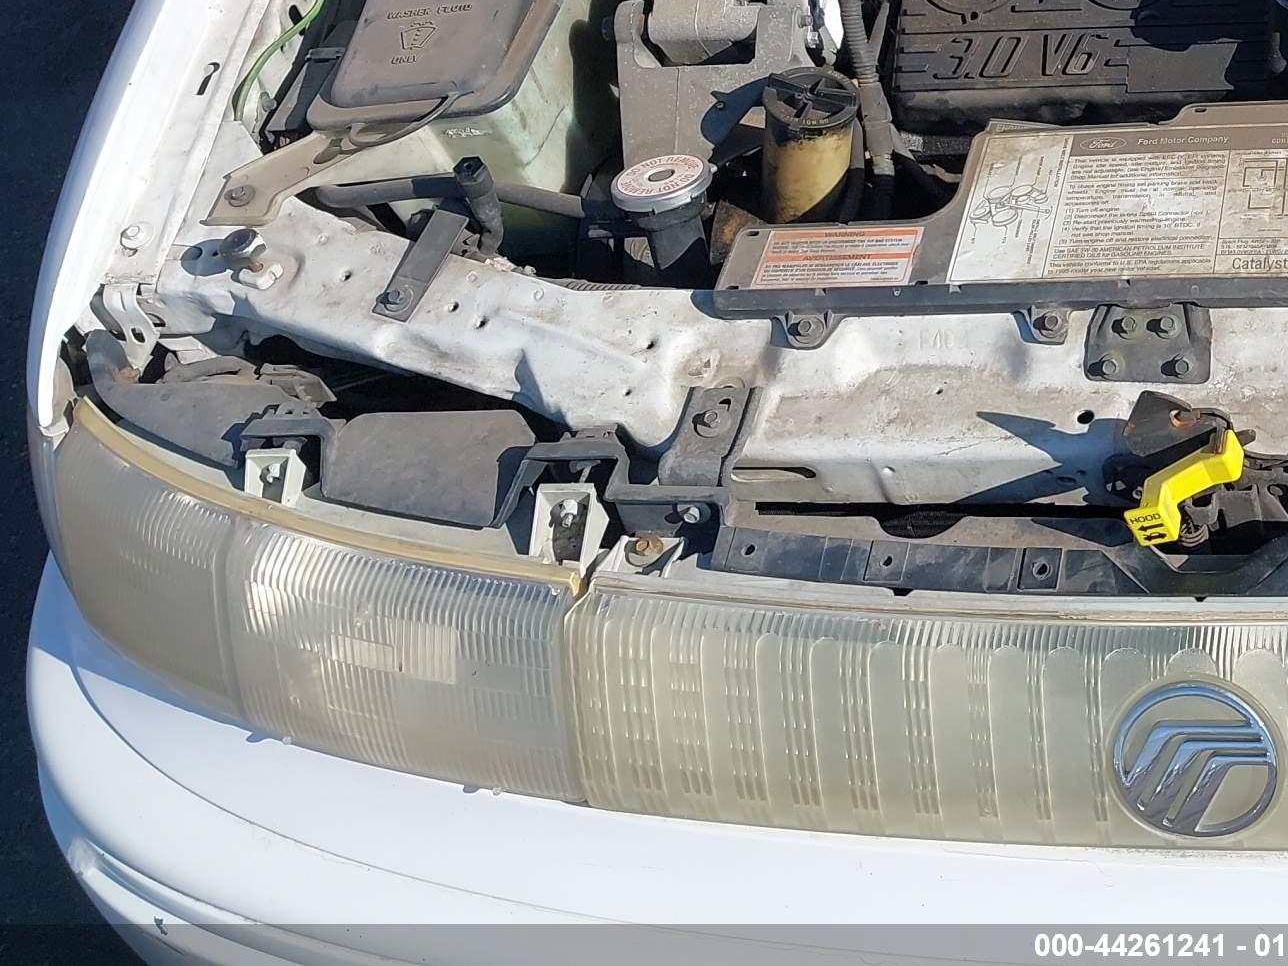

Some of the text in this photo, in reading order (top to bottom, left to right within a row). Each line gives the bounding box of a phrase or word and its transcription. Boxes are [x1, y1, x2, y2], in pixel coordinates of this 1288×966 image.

[387, 2, 472, 19] WASHER FLUID
[391, 55, 417, 65] ONLY
[933, 33, 1108, 80] 3.0 V6
[1188, 136, 1229, 144] Company
[641, 158, 662, 168] NOT
[658, 182, 680, 193] NOT
[802, 253, 872, 261] AVERTISSEMENT
[1232, 257, 1288, 272] Catalyst
[1129, 513, 1161, 524] HOOD
